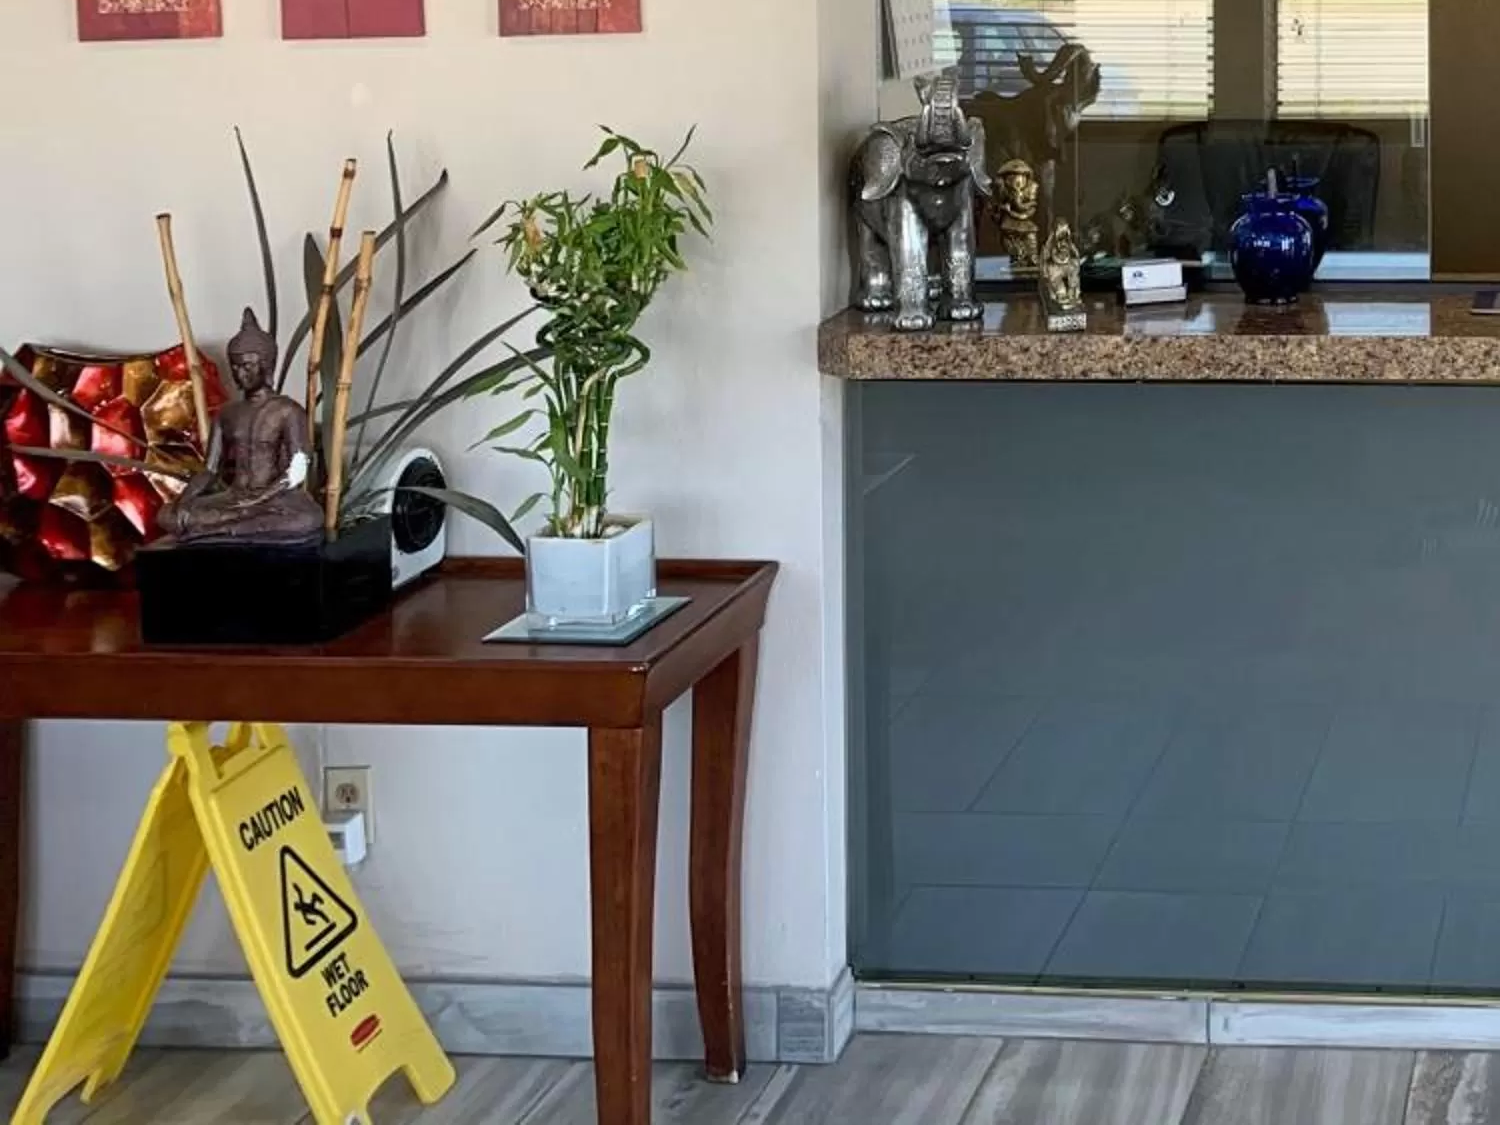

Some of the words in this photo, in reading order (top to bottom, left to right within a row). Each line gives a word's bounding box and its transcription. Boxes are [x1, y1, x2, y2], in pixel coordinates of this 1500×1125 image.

[239, 786, 305, 852] CAUTION
[321, 951, 351, 988] WET
[325, 969, 370, 1018] FLOOR
